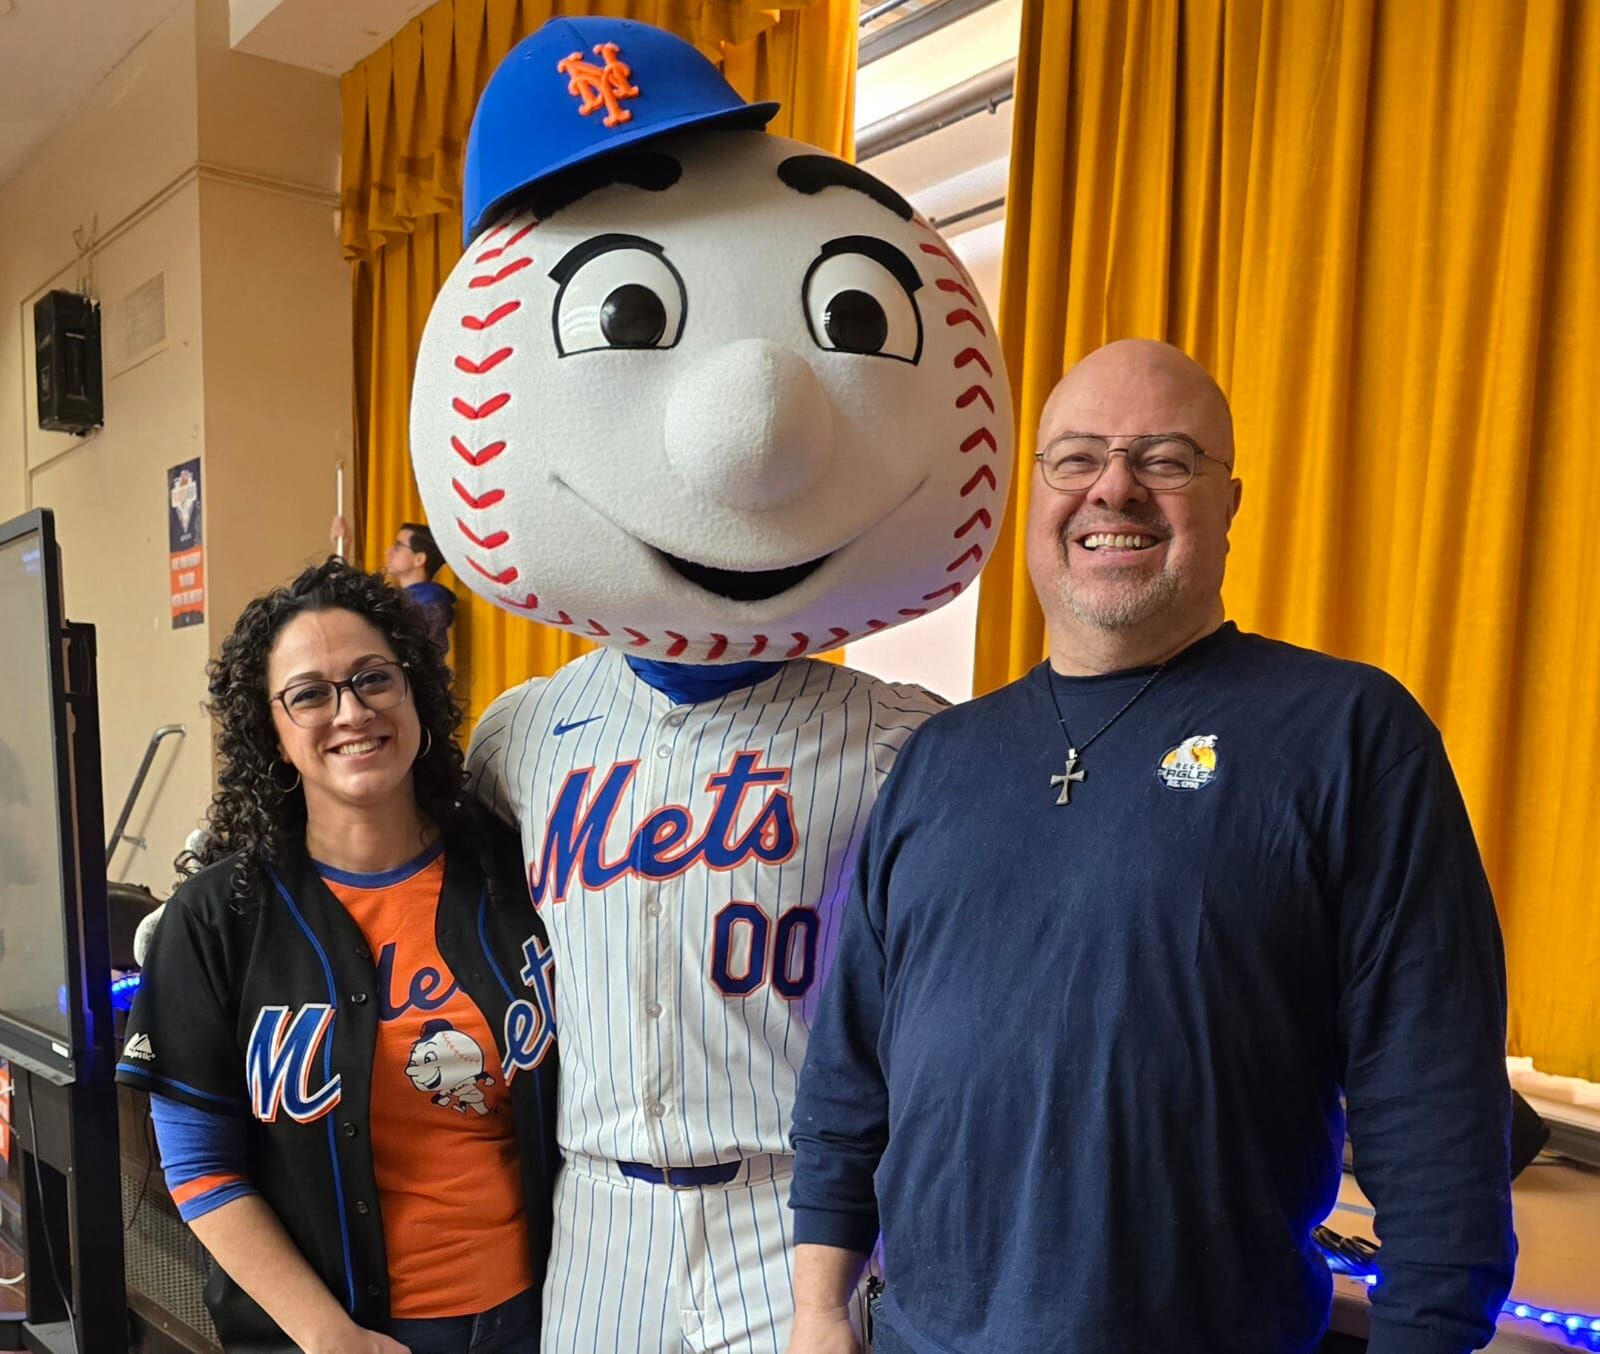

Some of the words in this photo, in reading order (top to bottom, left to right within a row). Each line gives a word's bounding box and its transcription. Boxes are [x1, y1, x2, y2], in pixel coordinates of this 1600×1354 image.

[529, 749, 799, 912] Mets
[501, 935, 557, 1087] et
[709, 900, 821, 1000] 00
